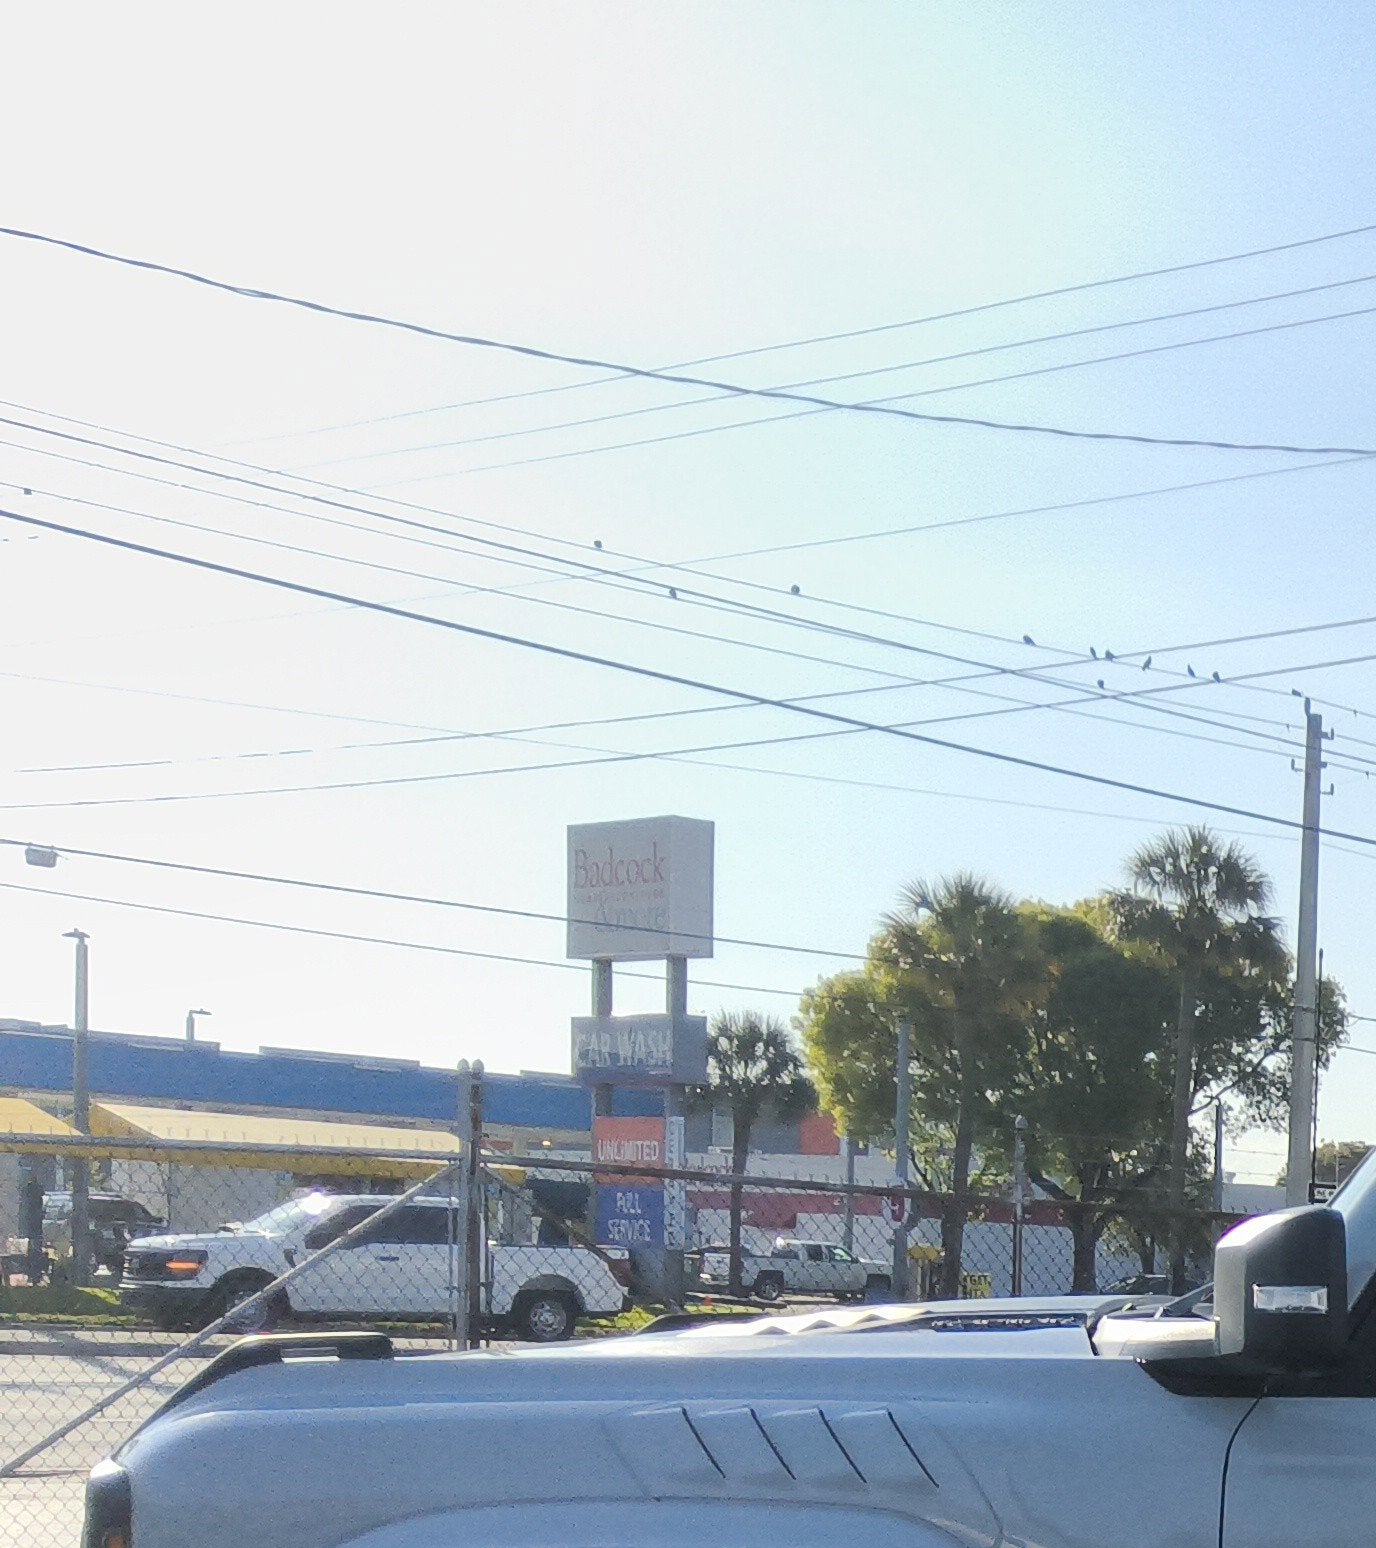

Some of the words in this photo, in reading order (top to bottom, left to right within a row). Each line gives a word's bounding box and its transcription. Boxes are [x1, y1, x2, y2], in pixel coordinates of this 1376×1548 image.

[574, 841, 665, 888] Badcock
[576, 1032, 611, 1067] CAR
[616, 1030, 673, 1066] WASH
[597, 1139, 660, 1161] UNLIMITED
